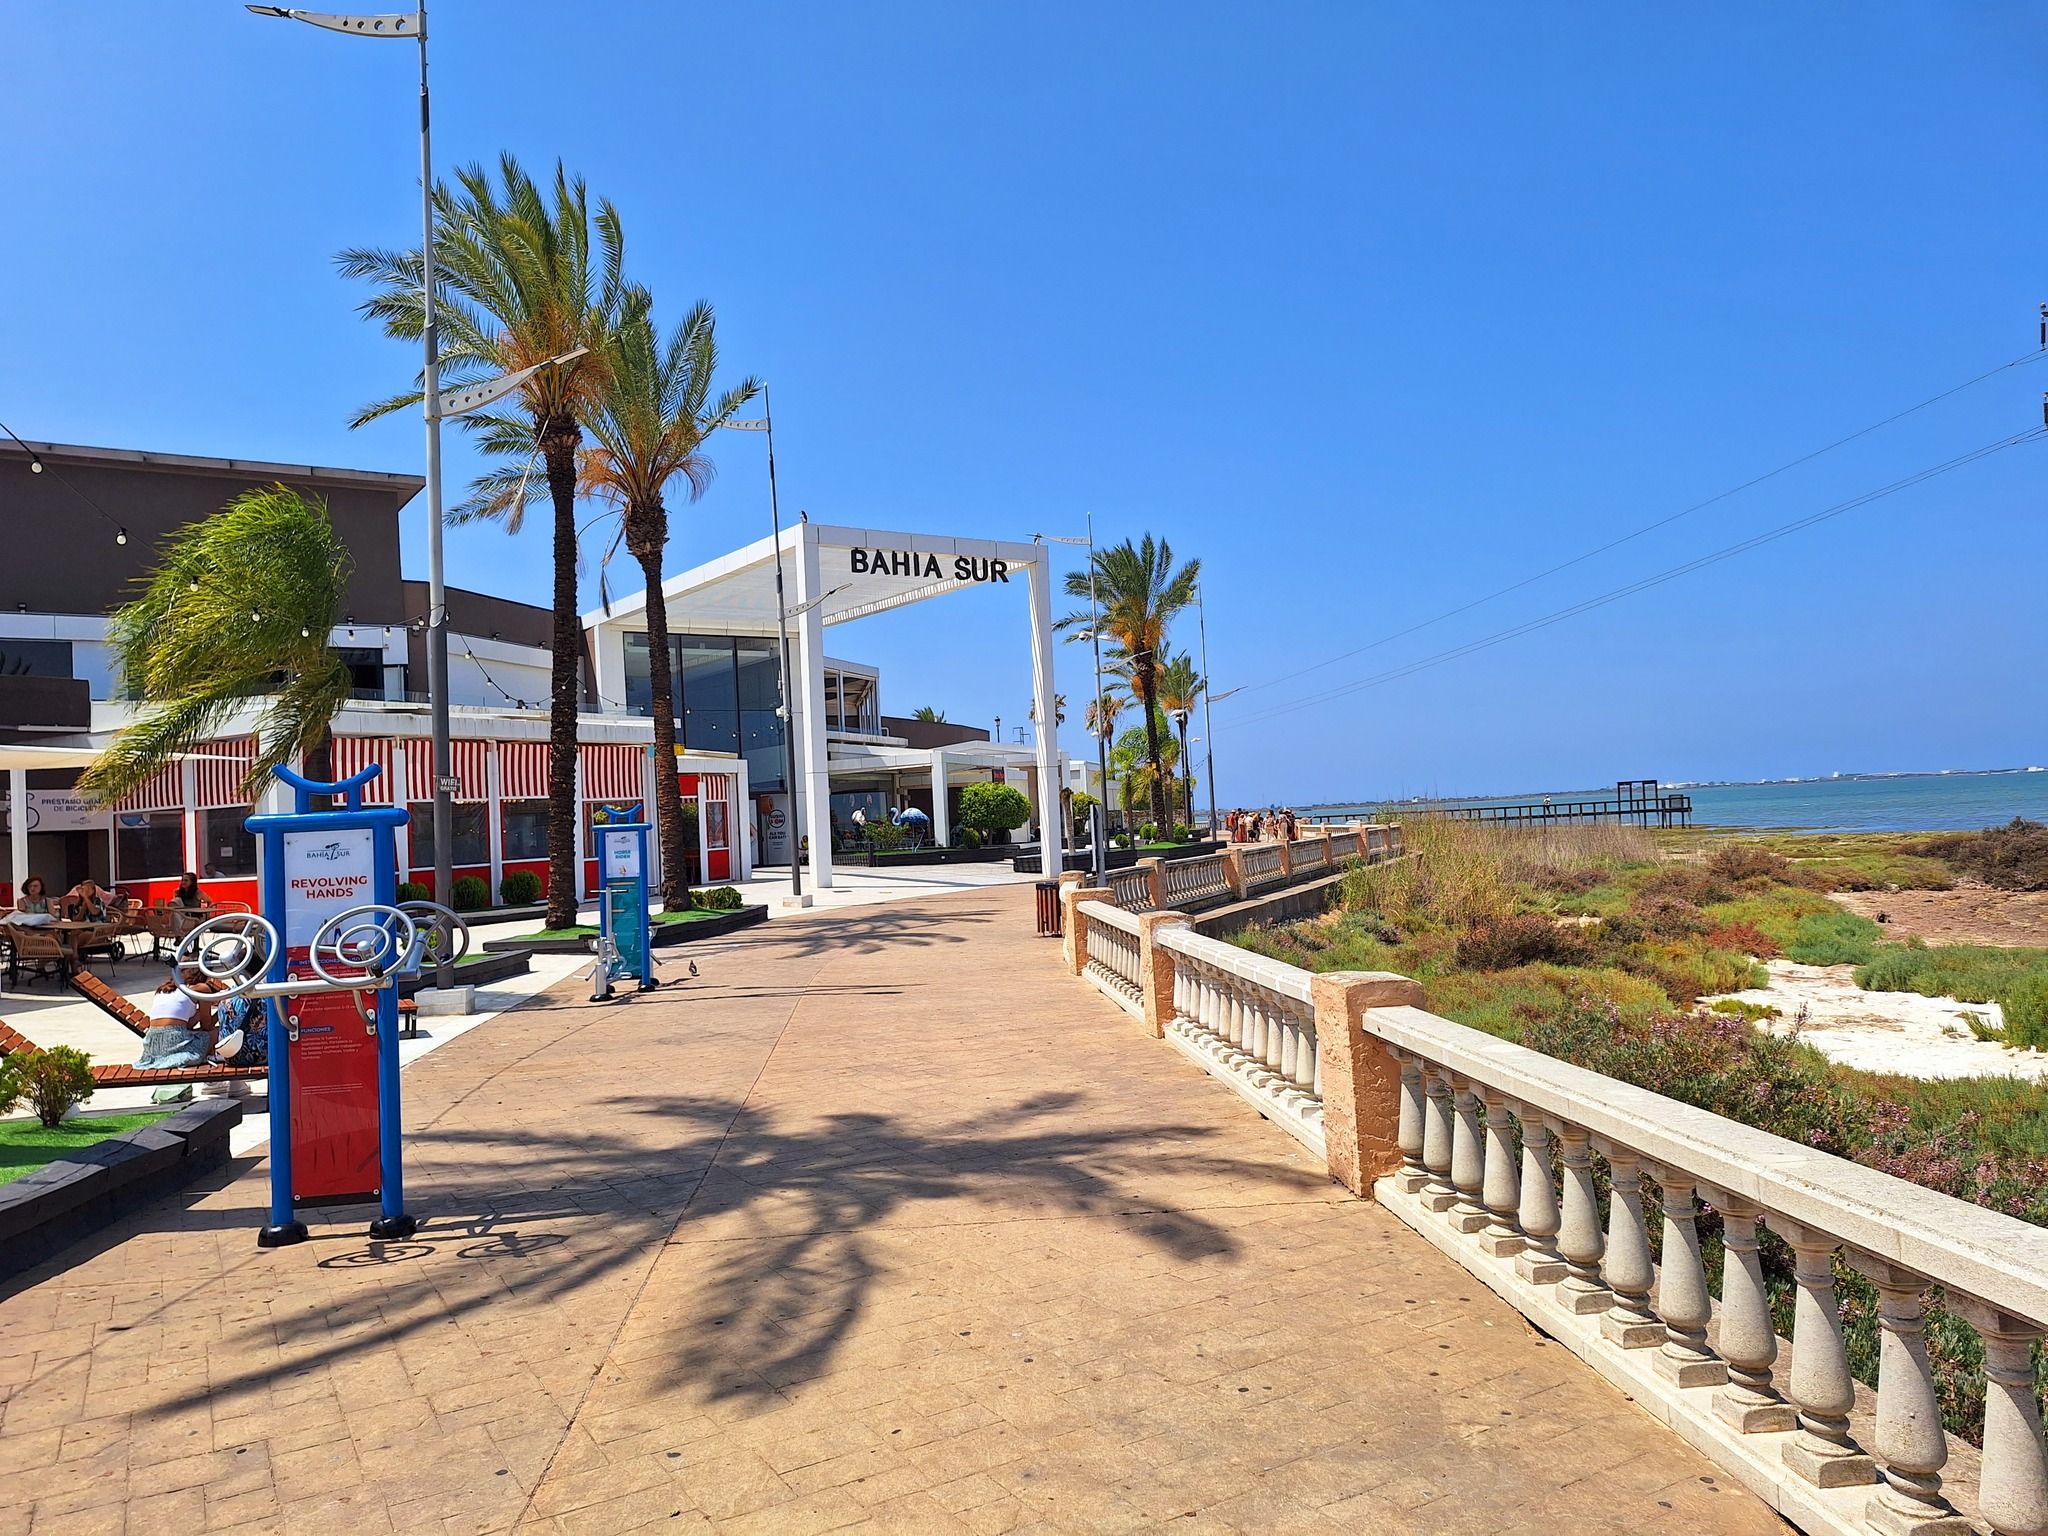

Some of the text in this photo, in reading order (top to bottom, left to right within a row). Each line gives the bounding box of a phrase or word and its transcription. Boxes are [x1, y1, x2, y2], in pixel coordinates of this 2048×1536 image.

[851, 547, 1009, 583] BAHIA SUR
[291, 875, 368, 889] REVOLVING
[306, 887, 354, 899] HANDS
